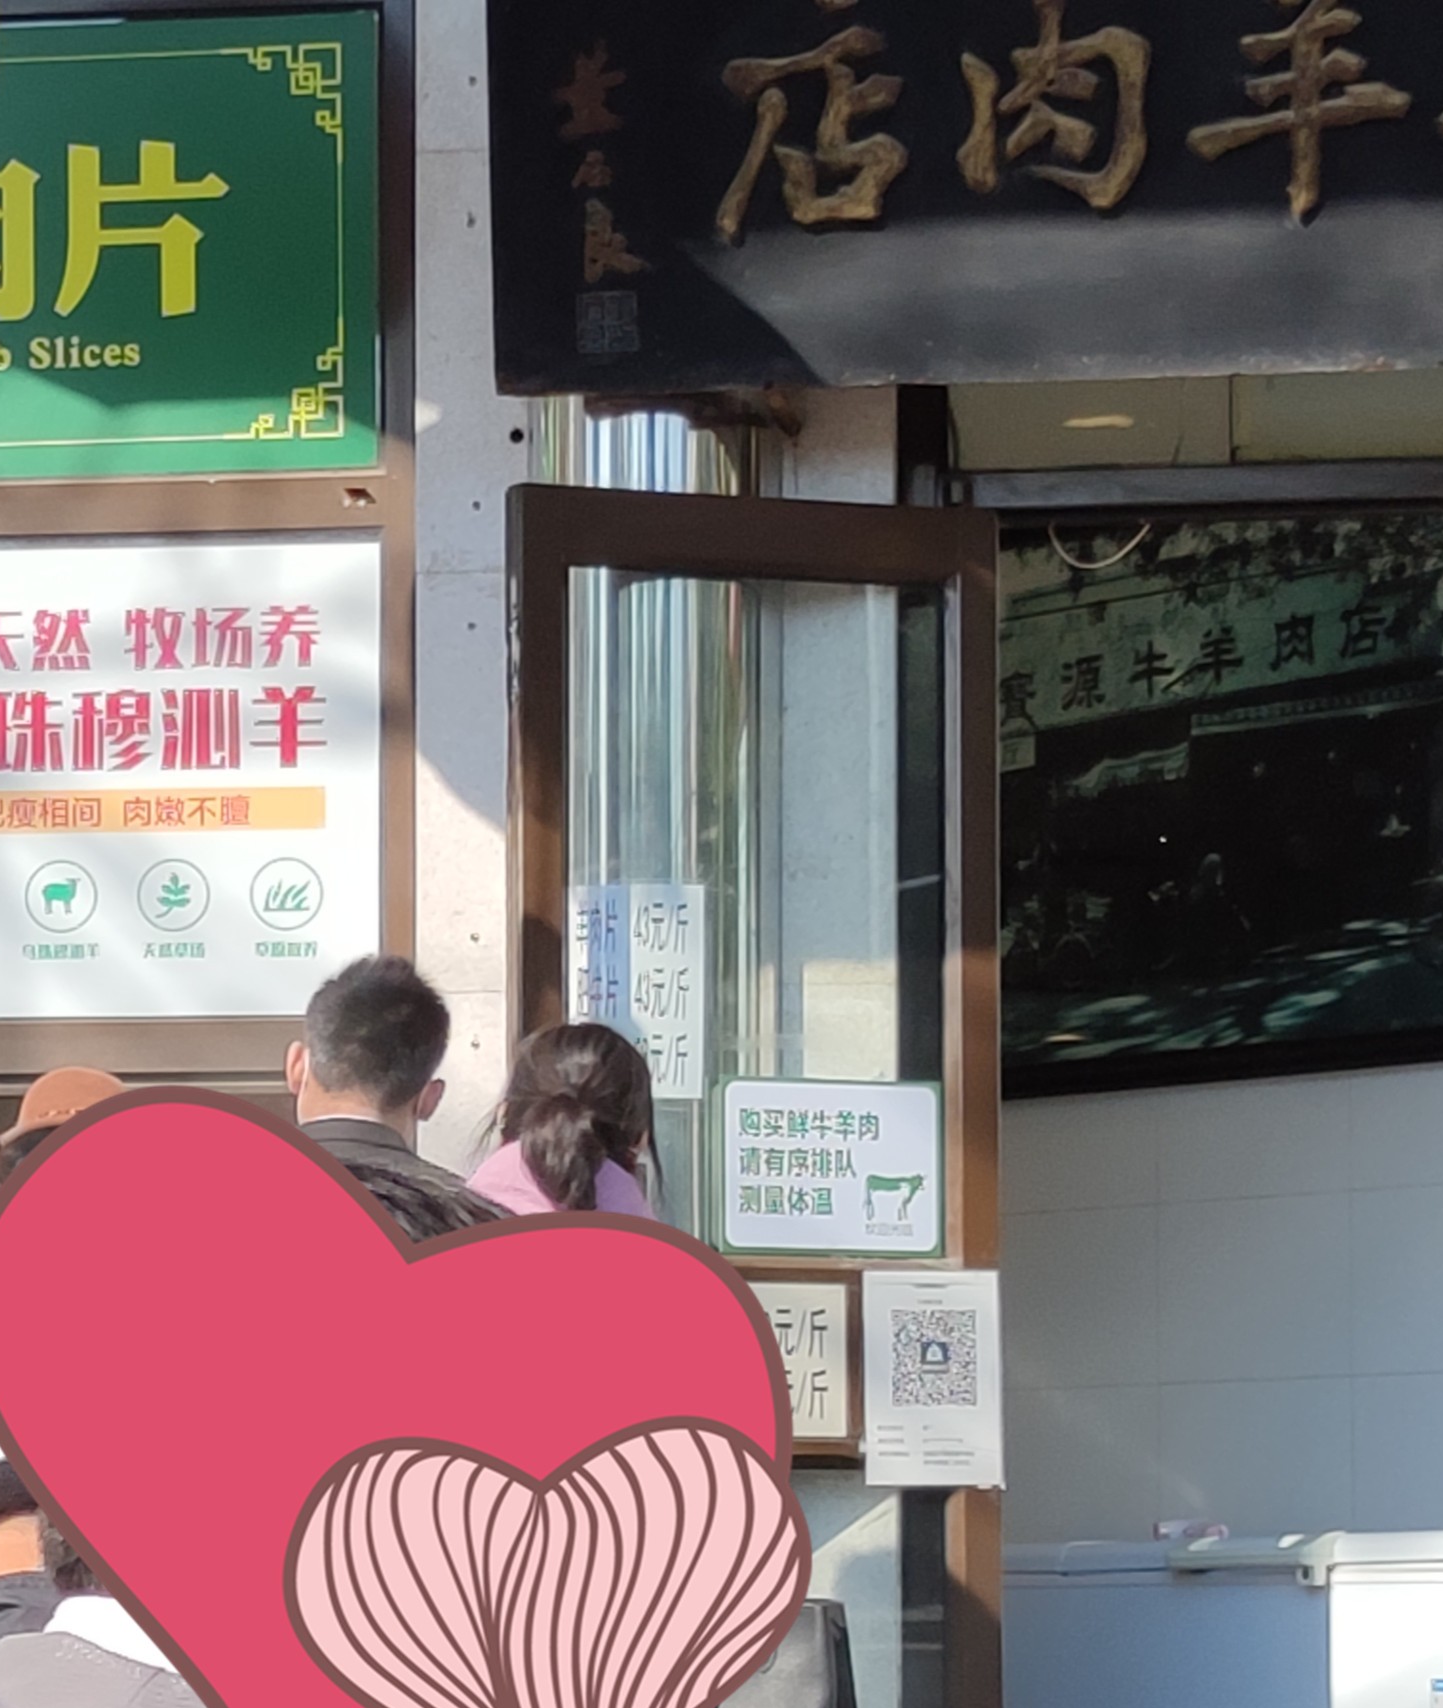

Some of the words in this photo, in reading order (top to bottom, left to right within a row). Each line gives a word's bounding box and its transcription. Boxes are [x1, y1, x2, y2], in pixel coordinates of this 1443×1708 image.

[27, 335, 141, 371] Slices
[124, 604, 322, 670] 牧场养
[122, 794, 251, 828] 肉嫩不膻
[738, 1107, 881, 1142] 购买鲜牛羊肉
[738, 1146, 858, 1179] 请有序排队
[738, 1184, 833, 1216] 测量体温
[765, 1308, 829, 1359] 元/斤
